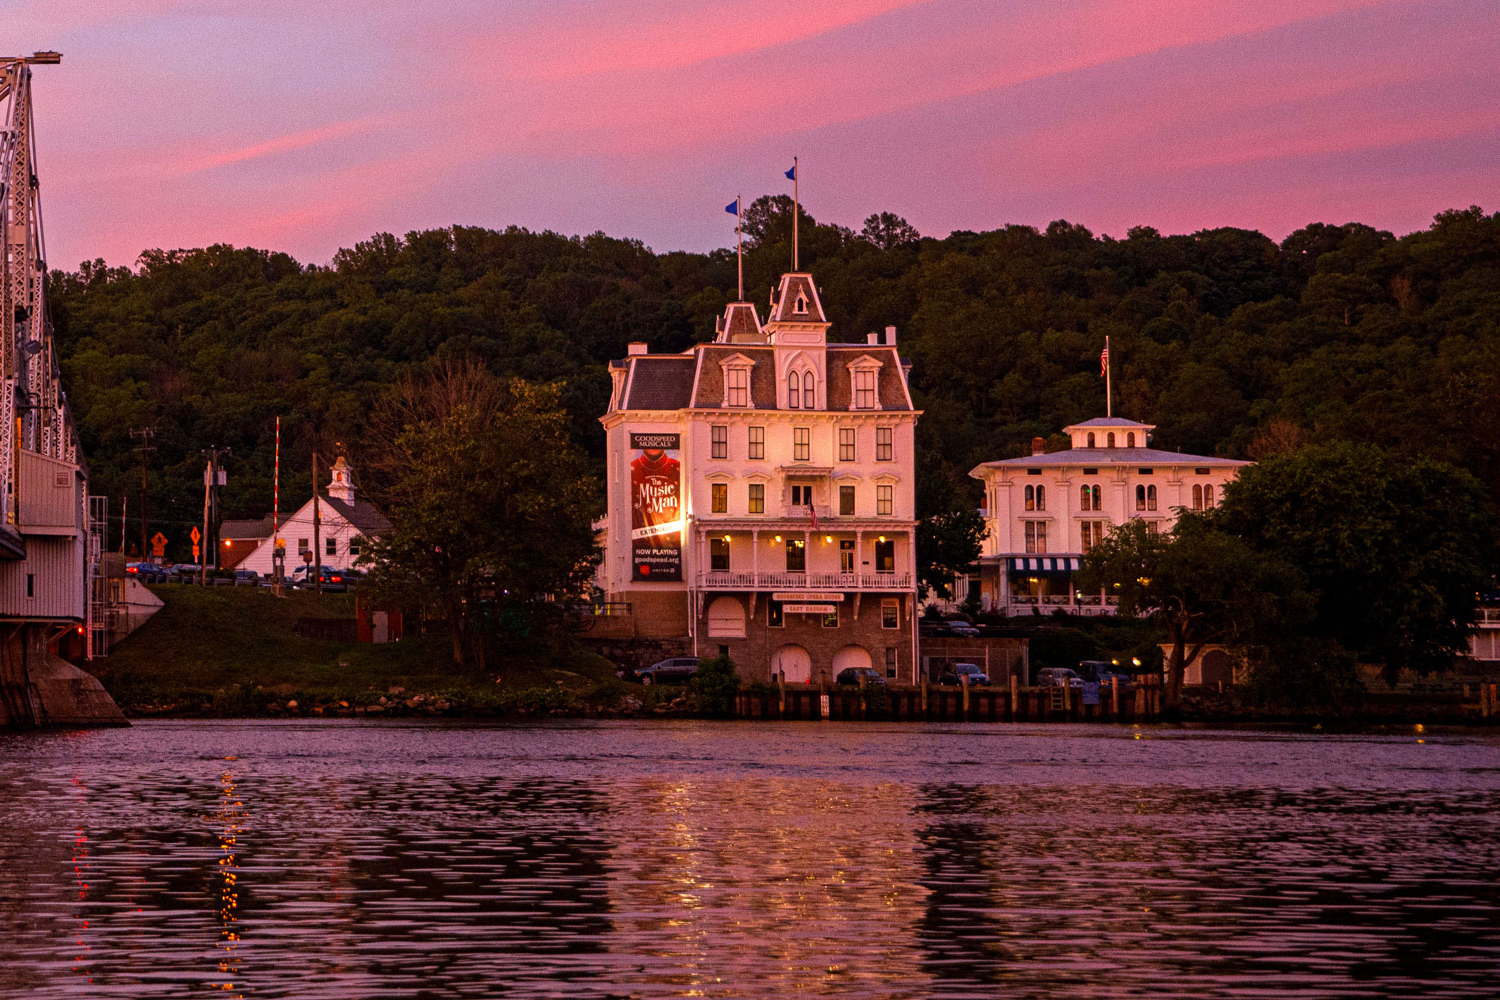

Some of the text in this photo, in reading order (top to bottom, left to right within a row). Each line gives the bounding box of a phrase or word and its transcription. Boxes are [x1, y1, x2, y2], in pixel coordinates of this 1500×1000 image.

[651, 478, 662, 486] The
[634, 482, 675, 509] Music
[647, 495, 678, 514] Man
[634, 556, 679, 564] goodspeed.org
